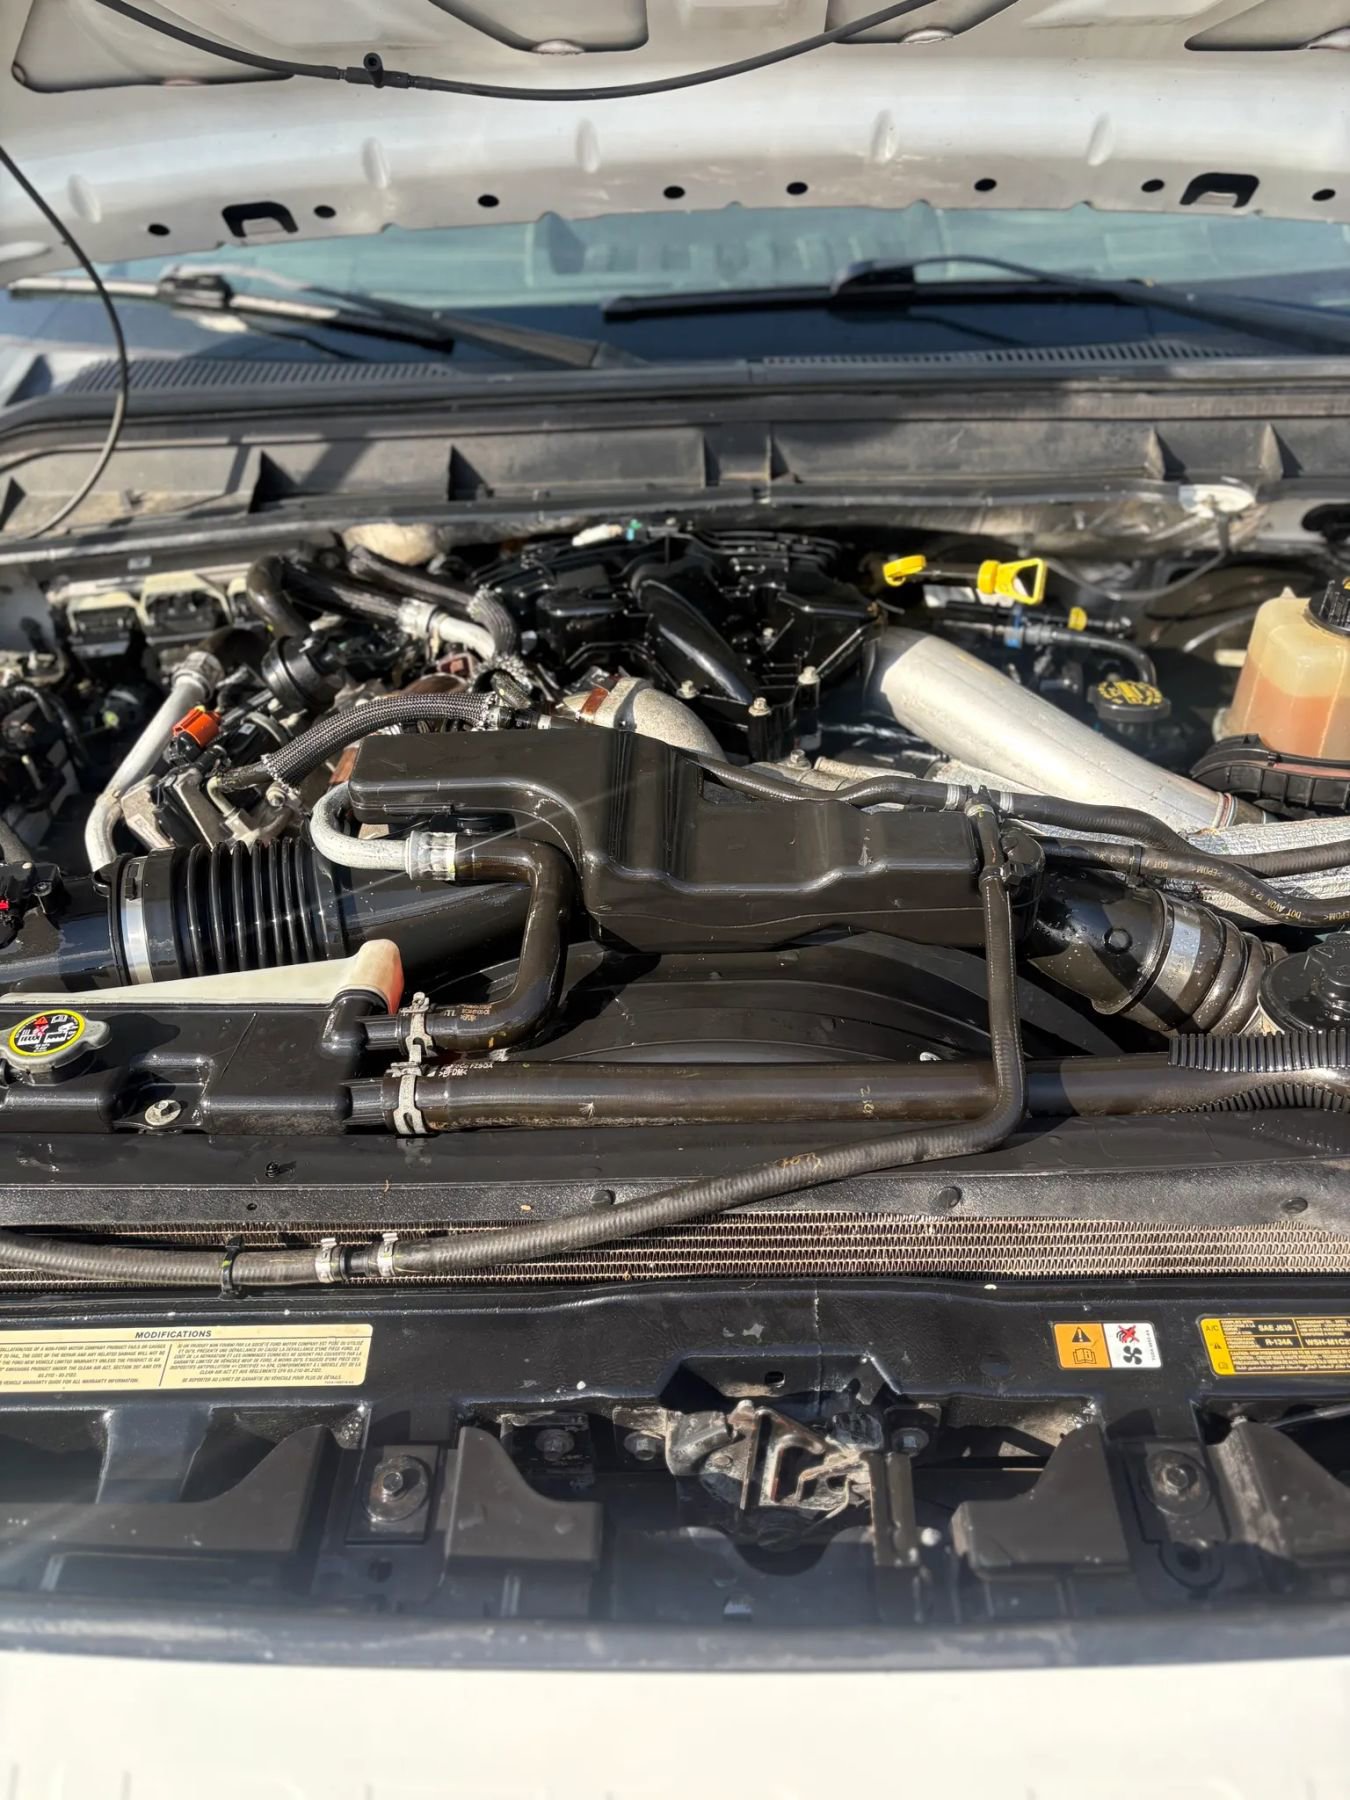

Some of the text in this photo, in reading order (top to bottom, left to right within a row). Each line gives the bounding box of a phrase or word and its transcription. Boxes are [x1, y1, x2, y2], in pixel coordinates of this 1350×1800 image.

[1152, 858, 1169, 870] DOT
[1265, 898, 1285, 914] AVON
[1286, 908, 1302, 920] DOT
[1257, 1324, 1274, 1332] SAE
[135, 1330, 212, 1339] MODIFICATIONS
[1264, 1338, 1294, 1346] R-134A
